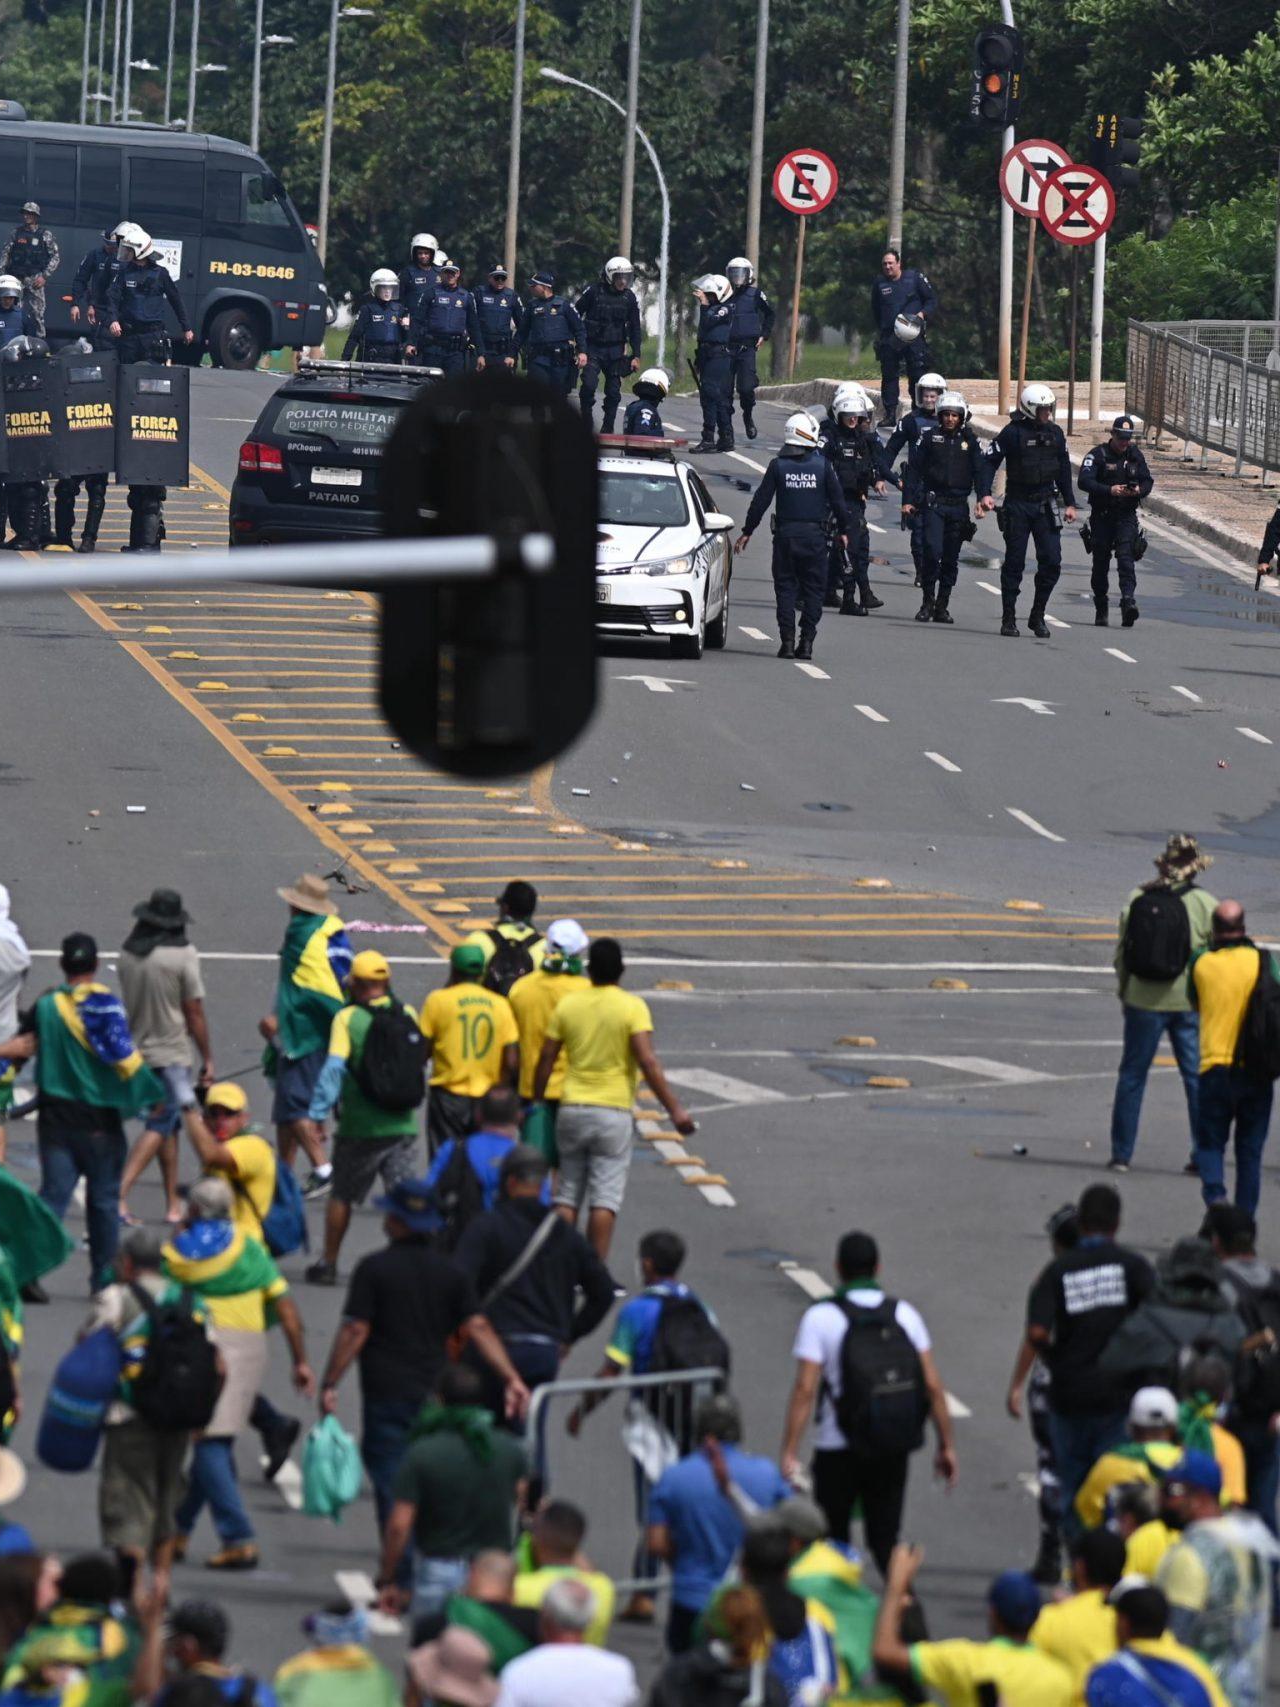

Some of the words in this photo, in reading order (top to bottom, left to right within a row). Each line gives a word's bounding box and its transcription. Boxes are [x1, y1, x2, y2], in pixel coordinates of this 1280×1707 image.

[792, 162, 818, 201] E
[209, 260, 295, 280] FN-03-0646
[69, 417, 113, 429] NACIONAL
[289, 420, 338, 429] DISTRITO
[132, 429, 178, 440] NACIONAL
[785, 472, 817, 481] POLÍCIA
[785, 480, 817, 489] MILITAR
[308, 491, 360, 503] PATAMO
[457, 1012, 495, 1060] 10
